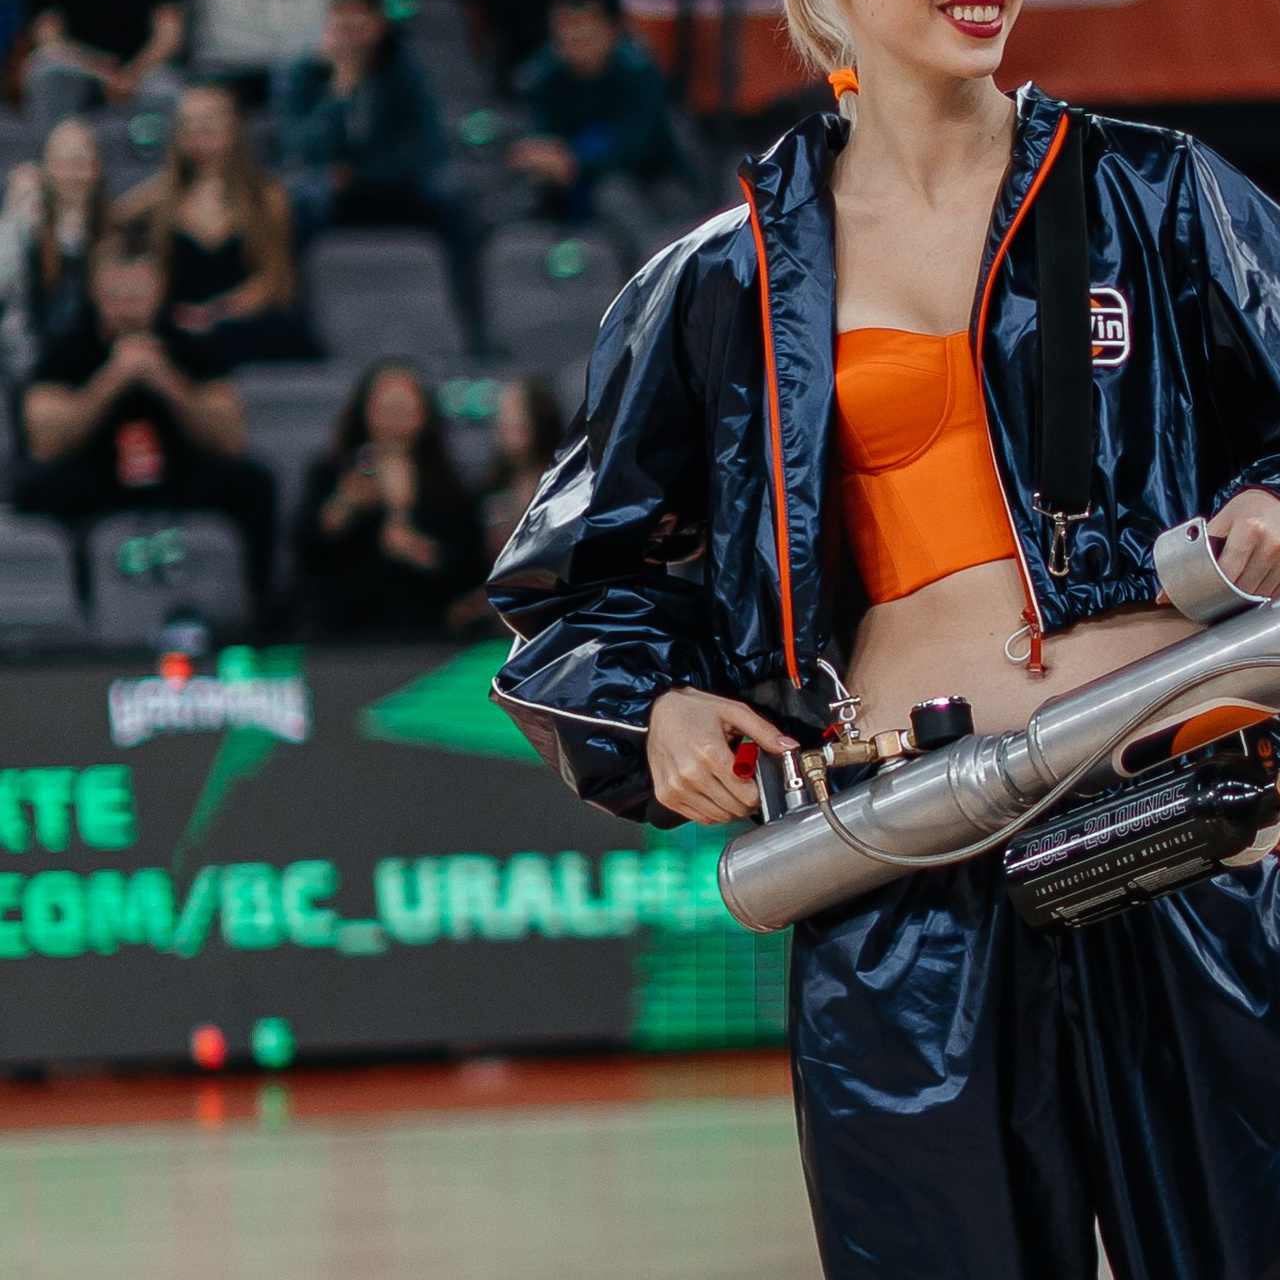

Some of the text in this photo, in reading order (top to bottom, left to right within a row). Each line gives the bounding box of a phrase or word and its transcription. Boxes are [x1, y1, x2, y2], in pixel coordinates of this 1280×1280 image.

[1090, 315, 1123, 339] in
[1084, 812, 1111, 851] 20
[1114, 782, 1189, 838] OUNCE
[1035, 862, 1111, 898] INSTRUCTIONS
[1115, 853, 1136, 867] AND
[1140, 830, 1195, 858] WARNINGS
